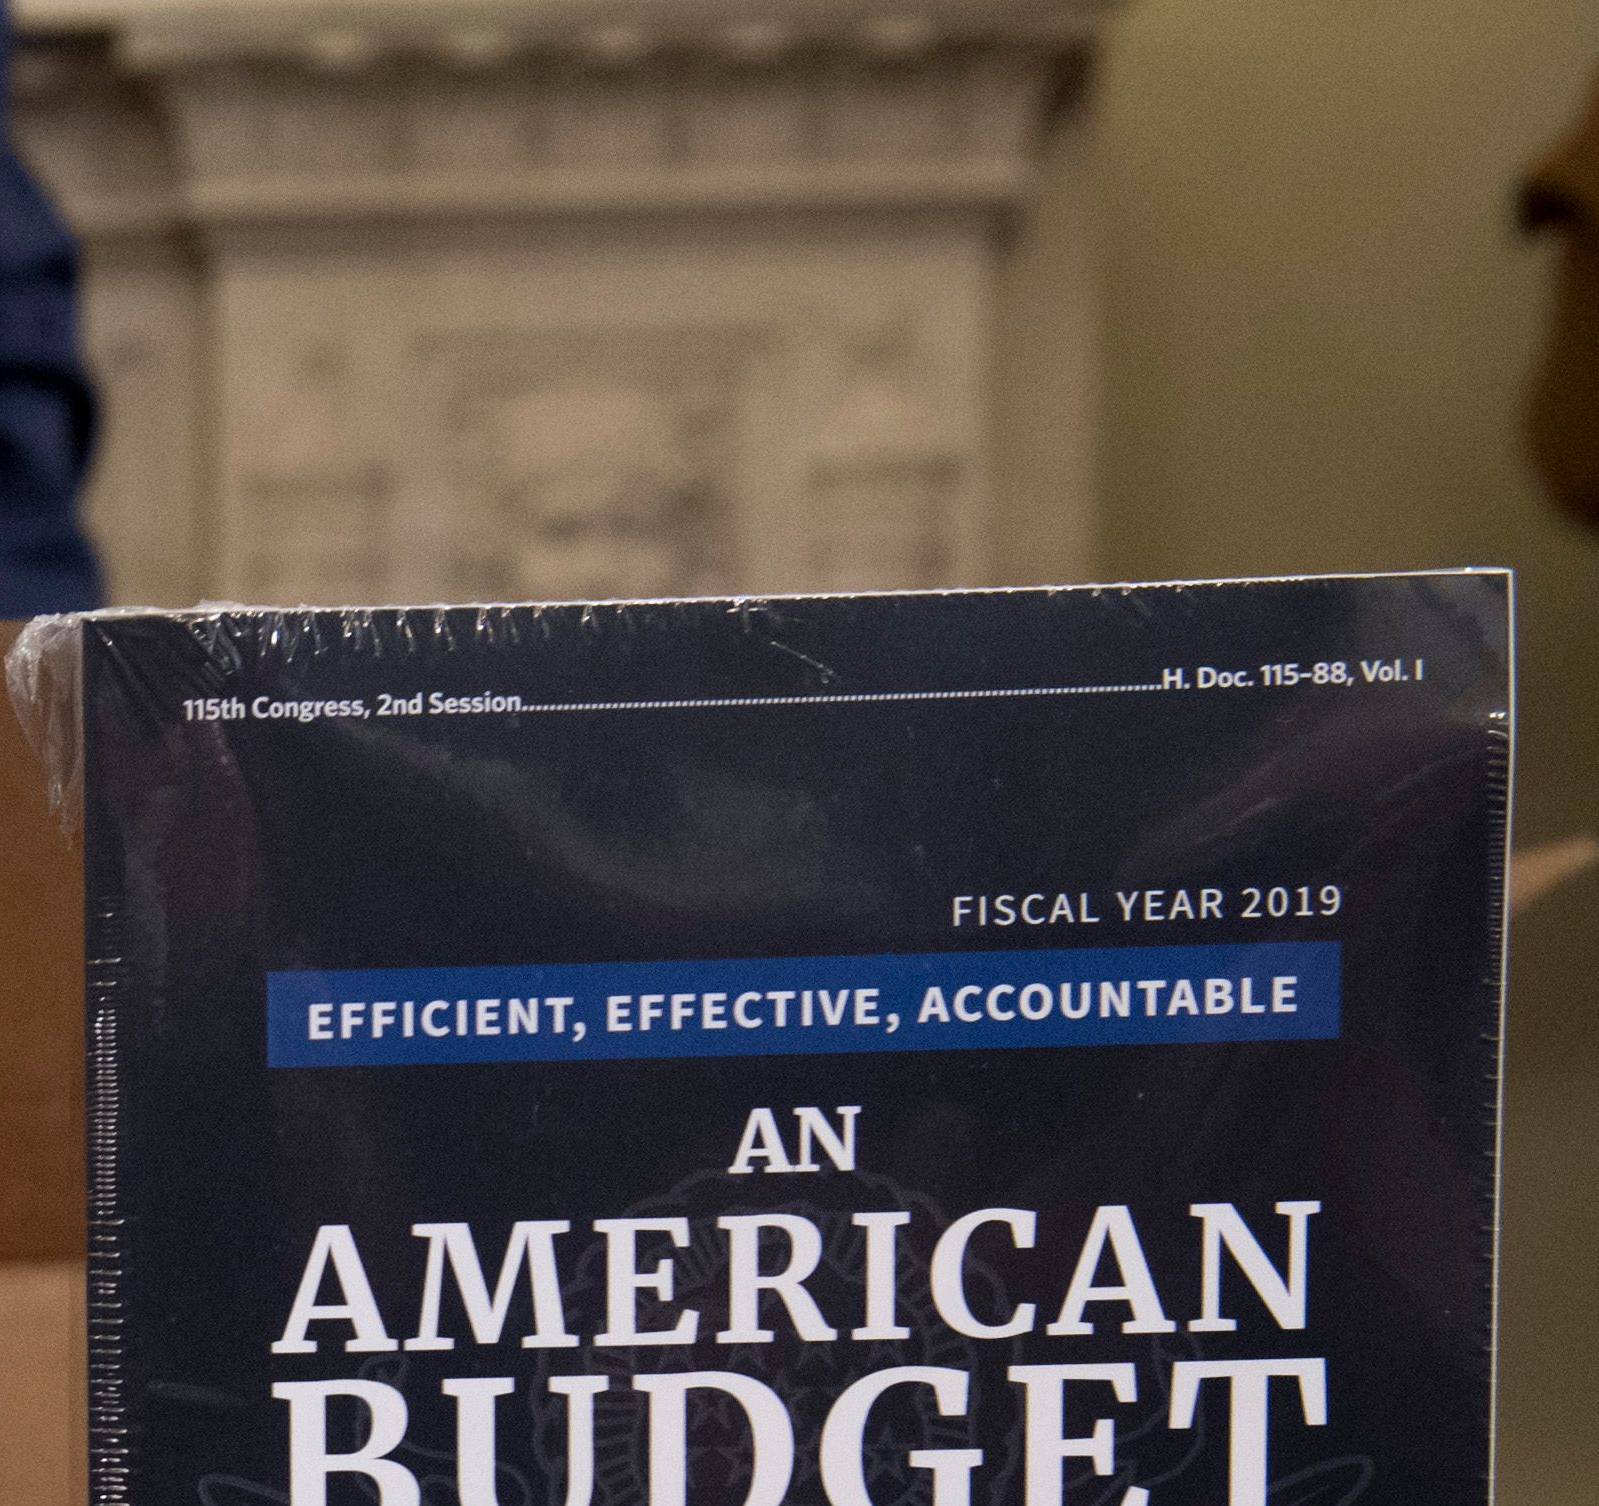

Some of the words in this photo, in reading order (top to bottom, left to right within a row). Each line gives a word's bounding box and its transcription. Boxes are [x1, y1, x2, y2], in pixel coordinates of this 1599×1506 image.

[183, 697, 245, 720] 115th
[252, 696, 370, 722] Congress,
[377, 692, 422, 715] 2nd
[1198, 667, 1253, 688] Doc.
[1361, 659, 1408, 682] Vol.
[1416, 659, 1422, 680] I
[954, 893, 1099, 926] FISCAL
[1117, 889, 1222, 921] YEAR
[1241, 885, 1340, 917] 2019
[309, 997, 586, 1042] EFFICIENT,
[607, 989, 899, 1033] EFFECTIVE,
[918, 976, 1297, 1023] ACCOUNTABLE
[728, 1106, 861, 1174] AN
[271, 1201, 1320, 1353] AMERICAN
